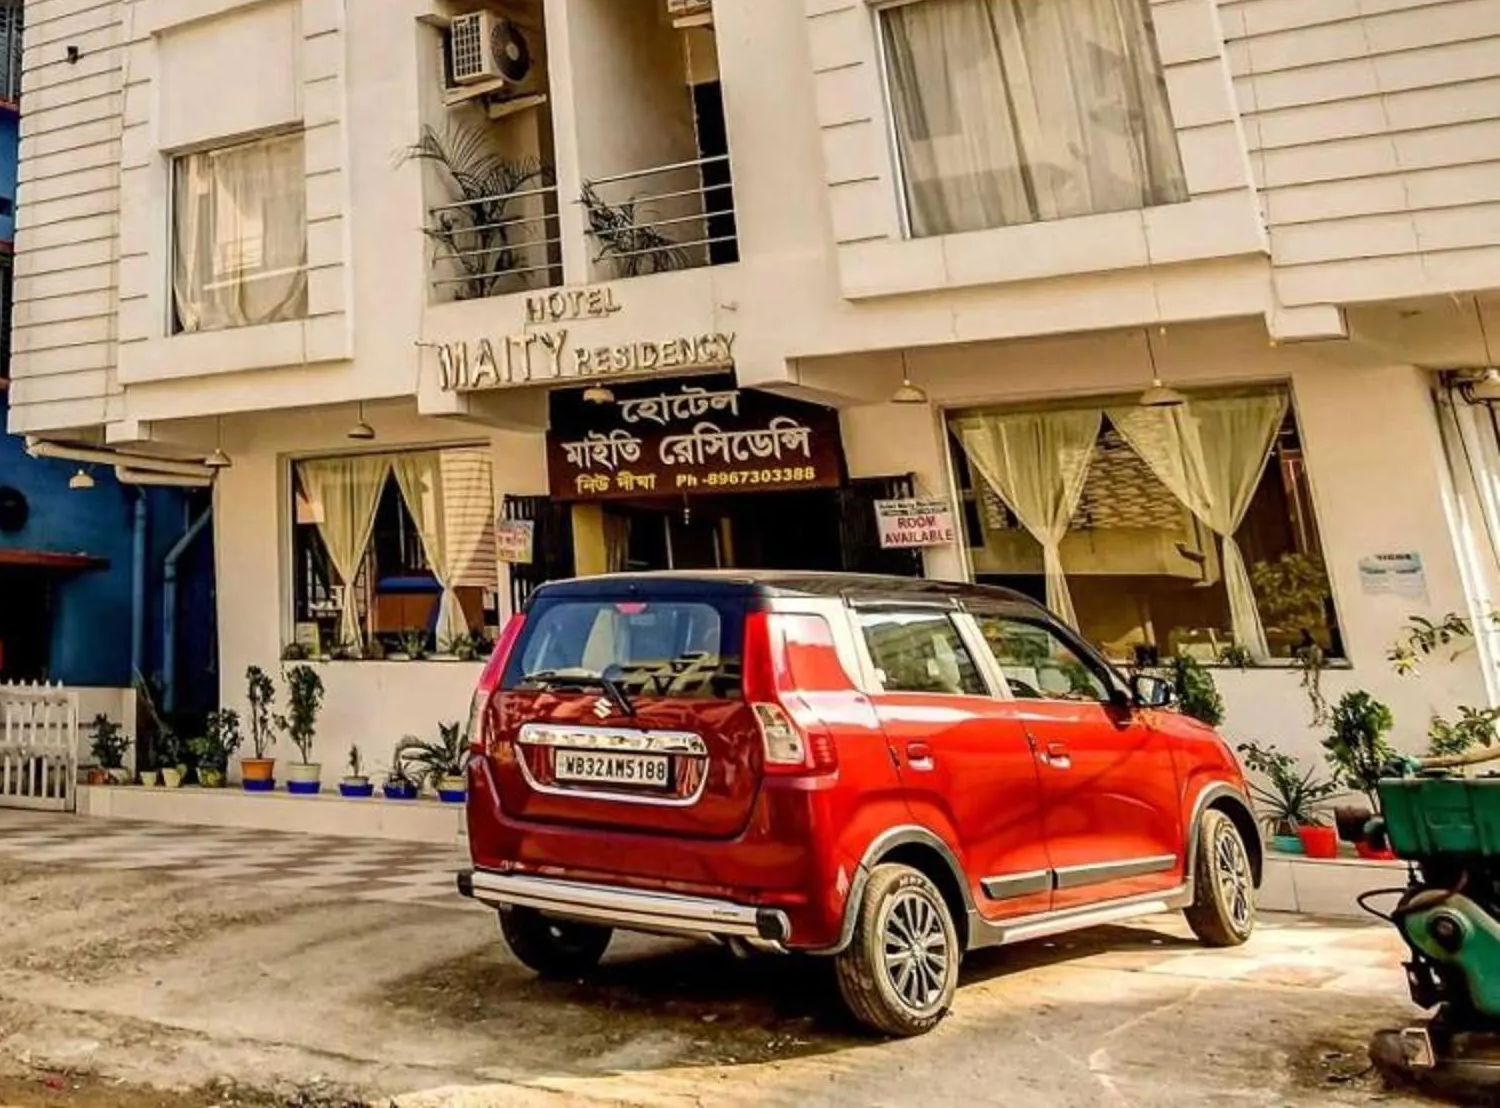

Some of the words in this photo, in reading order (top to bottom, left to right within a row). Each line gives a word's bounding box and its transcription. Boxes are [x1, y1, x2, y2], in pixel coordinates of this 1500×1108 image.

[526, 288, 621, 322] HOTEL
[437, 329, 568, 390] MAITY
[575, 332, 736, 375] RESIDENCY
[618, 385, 740, 425] হোটেল
[561, 429, 642, 469] মাইতি
[659, 416, 812, 465] রেসিডেন্সি
[575, 472, 610, 493] নিউ
[676, 474, 698, 488] Ph
[885, 529, 954, 544] AVAILABLE
[897, 515, 936, 529] ROOM
[565, 757, 665, 781] WB32AM5188
